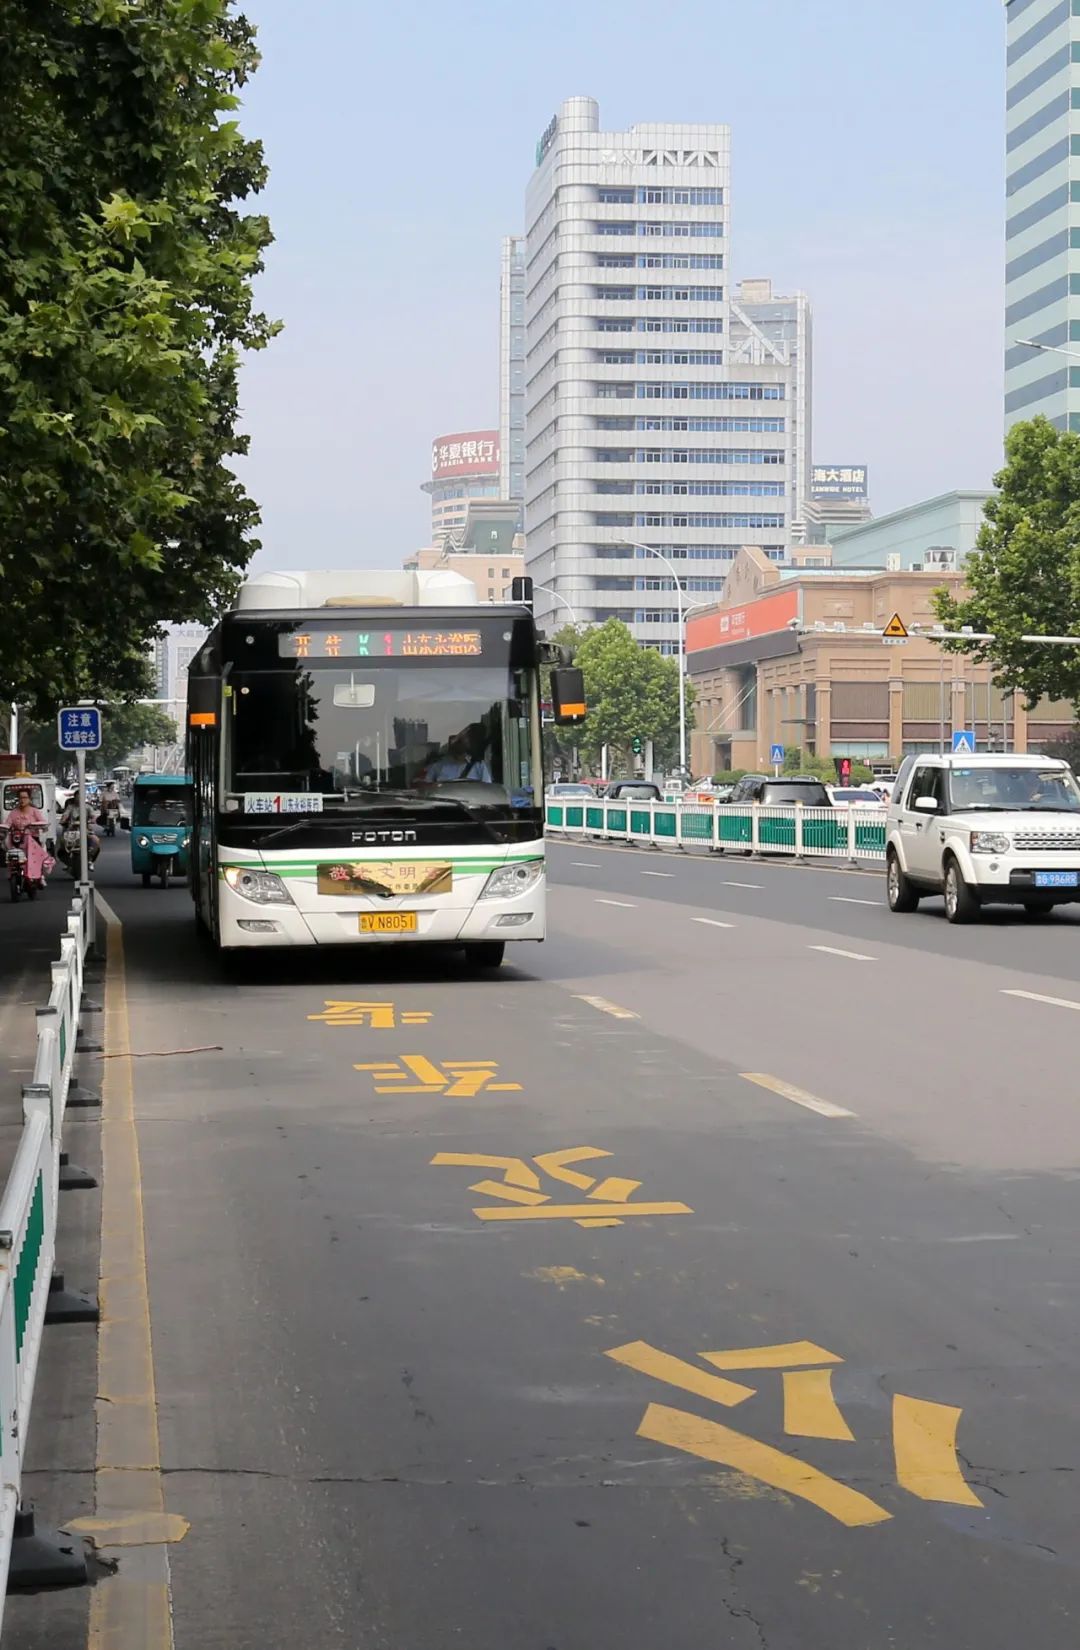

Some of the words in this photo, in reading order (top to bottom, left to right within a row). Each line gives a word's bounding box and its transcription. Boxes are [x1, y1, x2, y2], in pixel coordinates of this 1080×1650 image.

[439, 440, 495, 461] 华夏银行
[68, 712, 92, 727] 注意
[64, 730, 97, 745] 交通安全
[247, 796, 273, 813] 火车站
[273, 795, 281, 813] 1
[351, 830, 417, 842] FOTON
